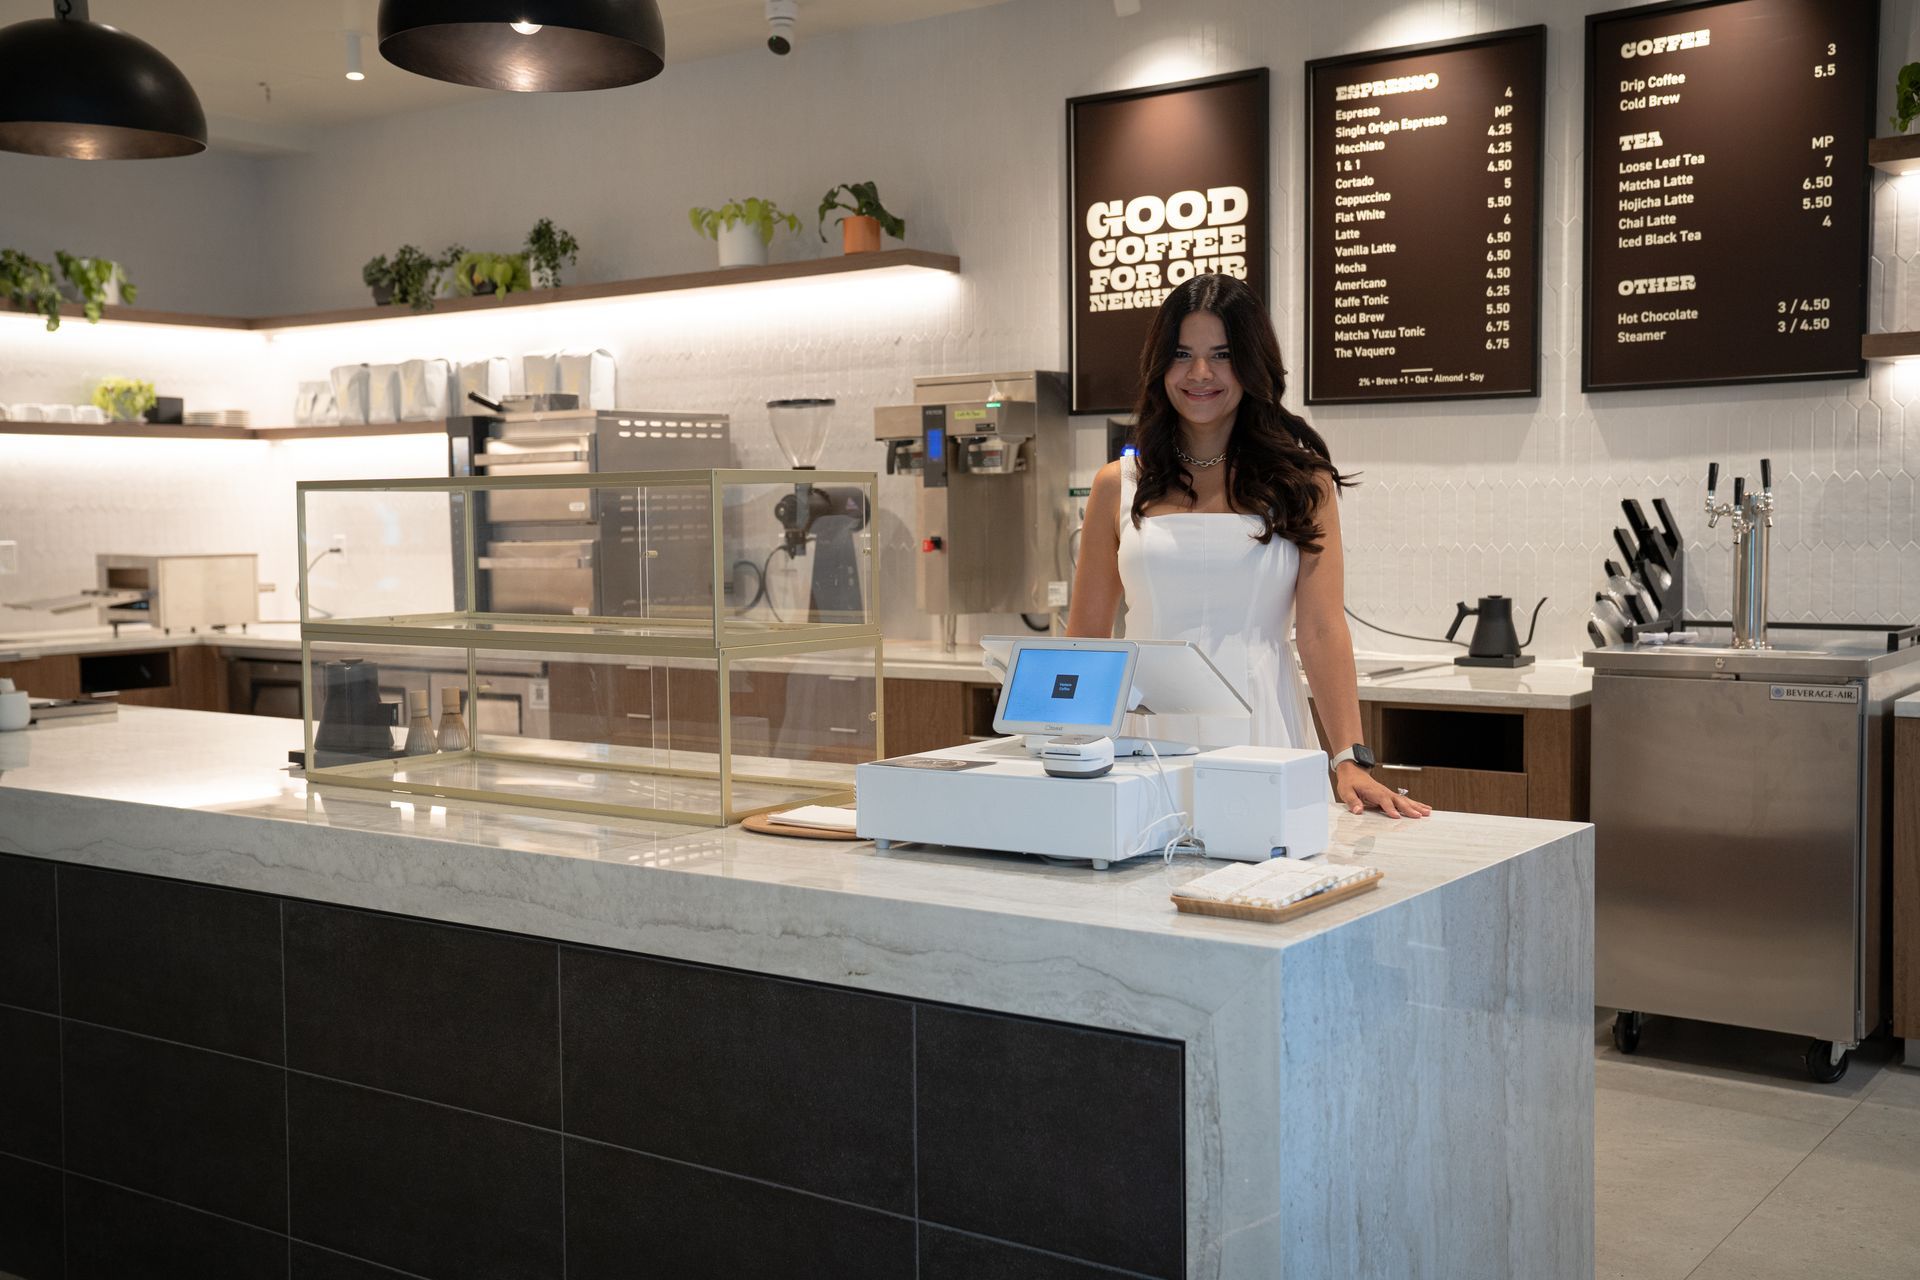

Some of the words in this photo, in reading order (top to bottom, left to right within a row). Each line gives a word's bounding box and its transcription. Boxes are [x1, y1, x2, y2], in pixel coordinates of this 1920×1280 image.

[1620, 29, 1711, 59] COFFEE
[1827, 43, 1837, 56] 3
[1814, 64, 1837, 79] 5.5
[1335, 72, 1440, 101] ESPRESSO
[1620, 79, 1645, 93] Drip
[1648, 72, 1686, 88] Coffee
[1504, 86, 1514, 98] 4
[1620, 97, 1646, 111] Cold
[1649, 93, 1681, 107] Brew
[1335, 107, 1381, 122] Espresso
[1494, 105, 1513, 118] MP
[1335, 124, 1367, 138] Single
[1368, 120, 1400, 135] Origin
[1401, 115, 1448, 131] Espresso
[1487, 123, 1513, 137] 4.25
[1335, 140, 1386, 156] Macchiato
[1487, 141, 1513, 155] 4.25
[1618, 131, 1664, 152] TEA
[1811, 135, 1835, 150] MP
[1336, 161, 1342, 172] 1
[1344, 160, 1352, 171] &
[1355, 159, 1361, 170] 1
[1487, 159, 1513, 173] 4.50
[1619, 160, 1652, 174] Loose
[1655, 155, 1681, 170] Leaf
[1683, 153, 1706, 166] Tea
[1824, 155, 1834, 168] 7
[1335, 175, 1375, 190] Cortado
[1504, 177, 1512, 189] 5
[1619, 177, 1661, 193] Matcha
[1663, 174, 1694, 188] Latte
[1802, 175, 1833, 191] 6.50
[1335, 191, 1392, 208] Cappuccino
[1487, 195, 1512, 208] 5.50
[1619, 197, 1662, 212] Hojicha
[1664, 193, 1695, 207] Latte
[1802, 195, 1832, 210] 5.50
[1086, 186, 1248, 239] GOOD
[1335, 212, 1355, 224] Flat
[1356, 209, 1386, 222] White
[1504, 213, 1512, 225] 6
[1618, 217, 1644, 230] Chai
[1646, 213, 1677, 227] Latte
[1821, 215, 1833, 228] 4
[1335, 229, 1361, 241] Latte
[1486, 231, 1512, 244] 6.50
[1618, 235, 1643, 249] Iced
[1645, 232, 1677, 246] Black
[1679, 230, 1702, 243] Tea
[1089, 225, 1246, 267] COFFEE
[1335, 245, 1369, 258] Vanilla
[1371, 242, 1397, 255] Latte
[1486, 249, 1512, 262] 6.50
[1089, 263, 1161, 293] FOR
[1167, 255, 1247, 286] OUR
[1335, 262, 1368, 275] Mocha
[1486, 267, 1511, 280] 4.50
[1335, 278, 1388, 292] Americano
[1486, 284, 1511, 298] 6.25
[1618, 275, 1697, 297] OTHER
[1335, 296, 1361, 308] Kaffe
[1362, 294, 1390, 307] Tonic
[1486, 302, 1511, 315] 5.50
[1777, 301, 1787, 314] 3
[1800, 298, 1831, 312] 4.50
[1335, 313, 1357, 326] Cold
[1359, 312, 1385, 324] Brew
[1618, 313, 1638, 325] Hot
[1640, 308, 1699, 323] Chocolate
[1485, 320, 1510, 333] 6.75
[1777, 320, 1787, 333] 3
[1800, 317, 1830, 331] 4.50
[1335, 330, 1370, 342] Matcha
[1372, 328, 1397, 340] Yuzu
[1398, 326, 1426, 338] Tonic
[1617, 330, 1667, 344] Steamer
[1334, 347, 1353, 359] The
[1354, 345, 1396, 359] Vaquero
[1485, 338, 1510, 351] 6.75
[1358, 378, 1371, 387] 2%
[1376, 376, 1398, 386] Breve
[1415, 375, 1428, 384] Oat
[1434, 373, 1464, 383] Almond
[1470, 372, 1485, 383] Soy
[1786, 689, 1855, 699] BEVERAGE-AIR
